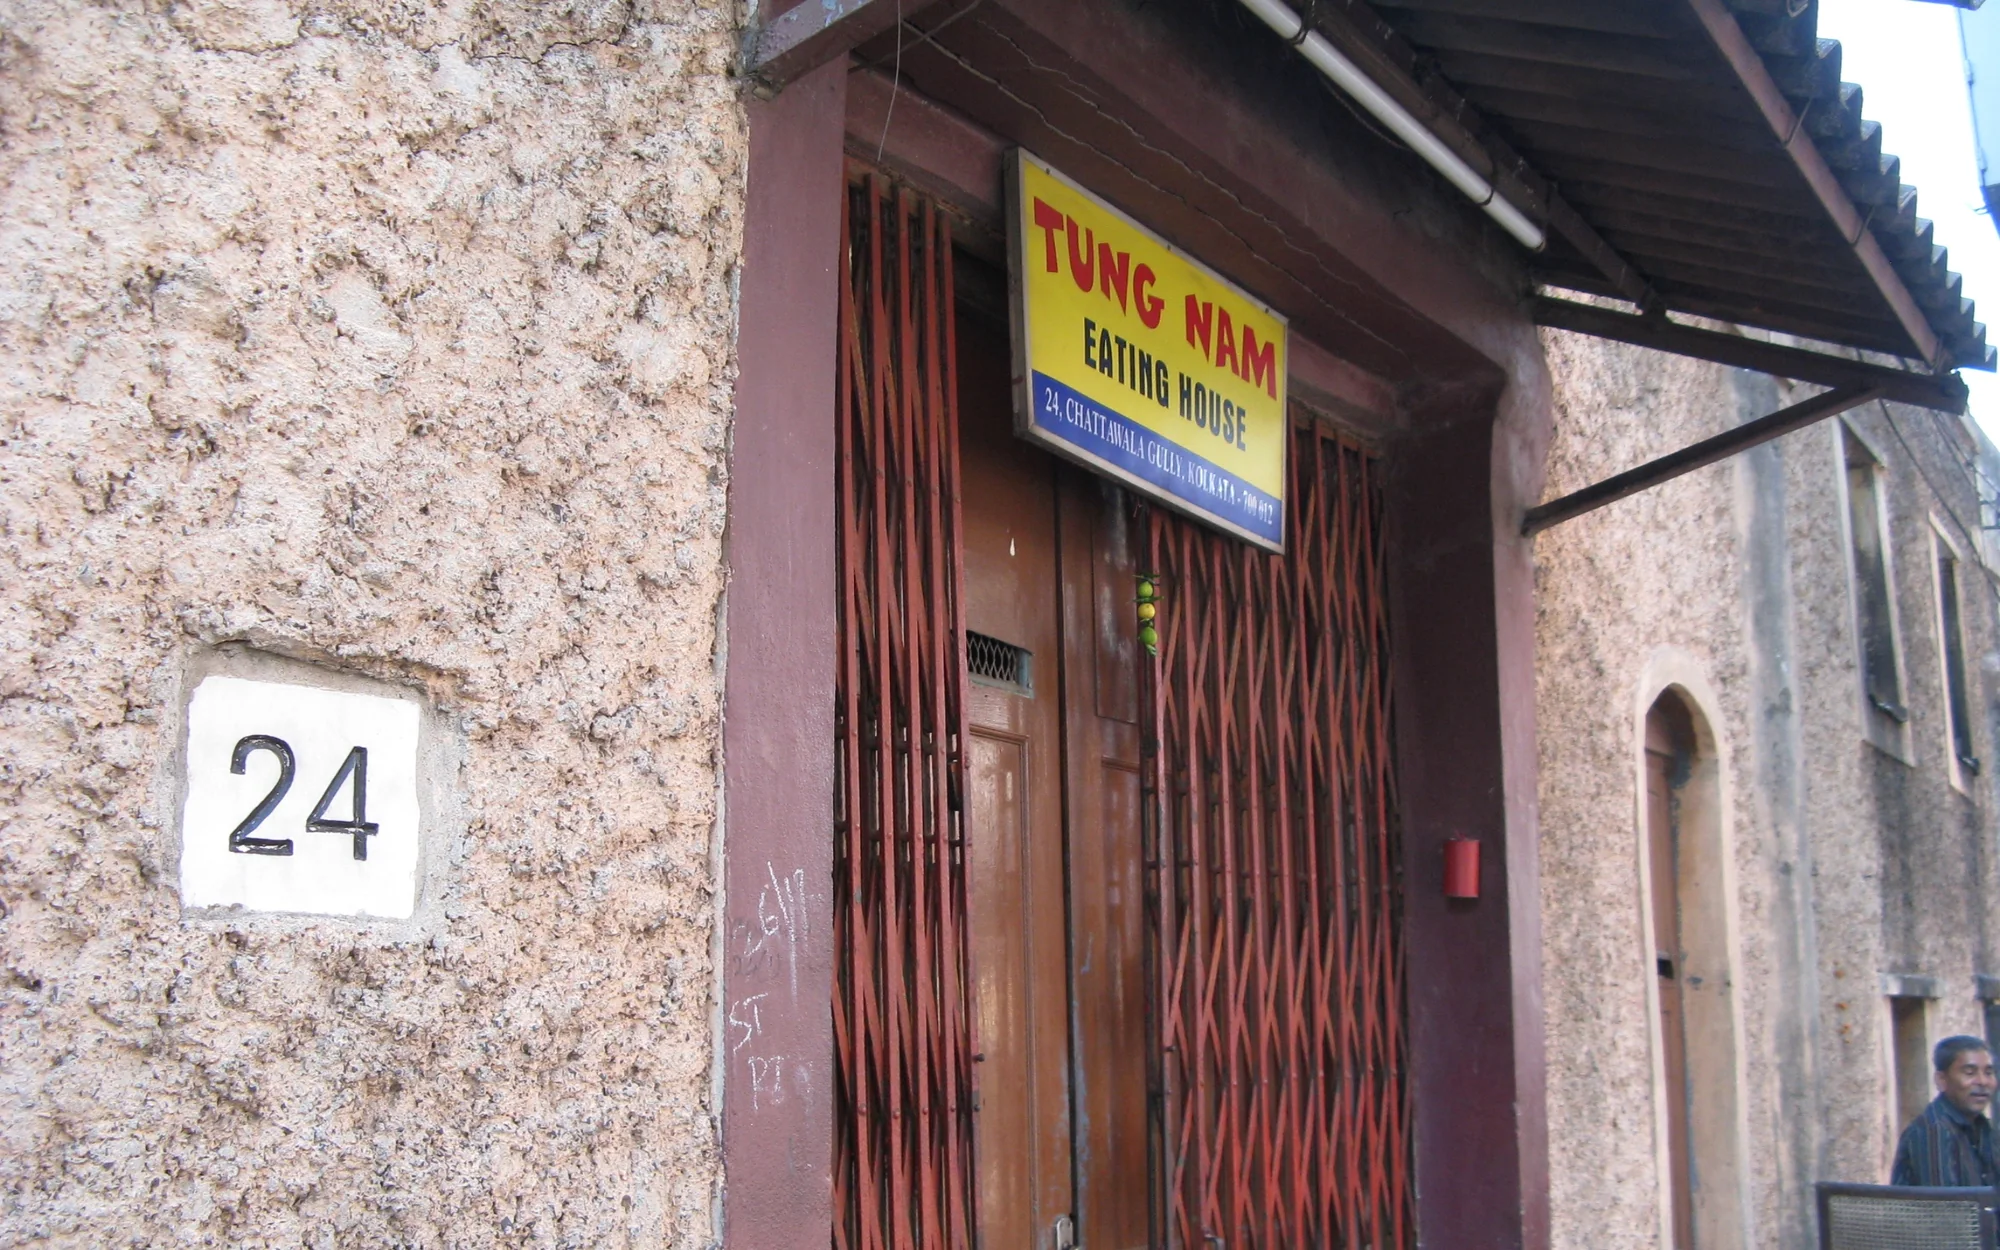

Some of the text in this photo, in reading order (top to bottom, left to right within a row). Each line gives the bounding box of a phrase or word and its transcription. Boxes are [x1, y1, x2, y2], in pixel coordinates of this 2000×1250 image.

[1033, 196, 1277, 401] TUNG NAM
[1045, 387, 1063, 421] 24,
[1066, 397, 1145, 459] CHATTAWALA
[1147, 440, 1185, 483] GULLY,
[1188, 461, 1235, 505] KOLKATA
[1084, 317, 1246, 452] EATING HOUSE
[229, 734, 379, 861] 24
